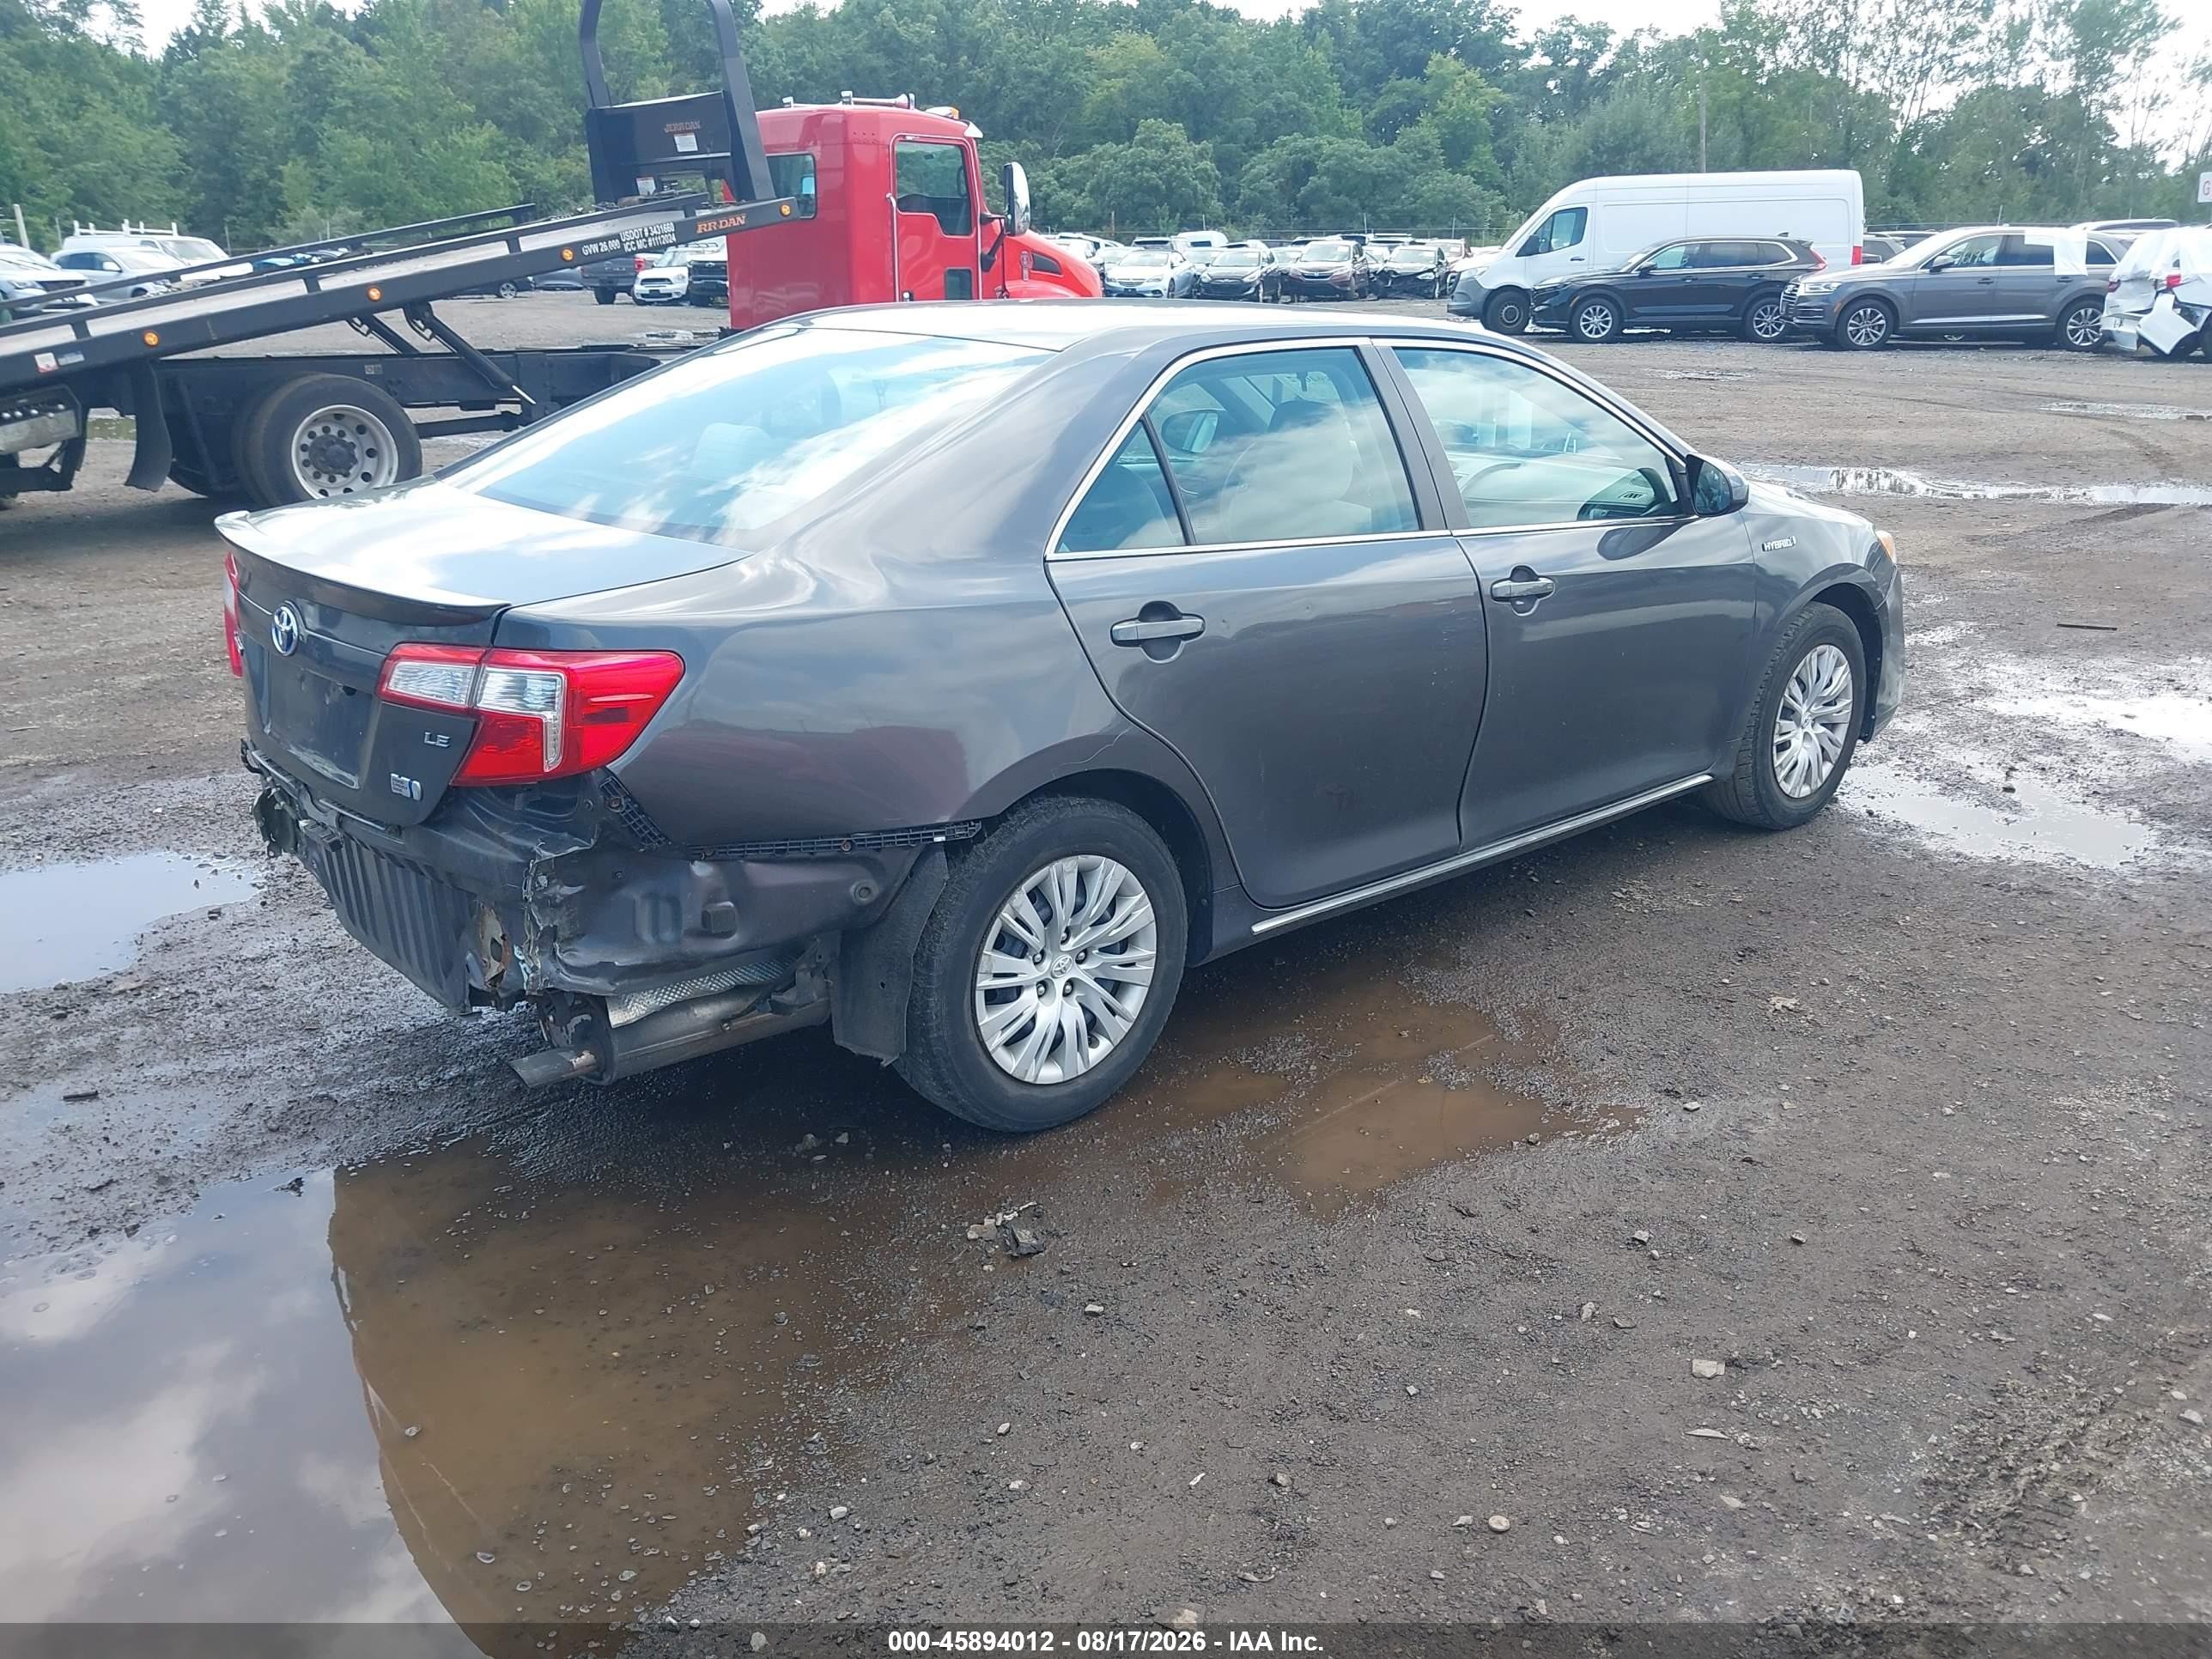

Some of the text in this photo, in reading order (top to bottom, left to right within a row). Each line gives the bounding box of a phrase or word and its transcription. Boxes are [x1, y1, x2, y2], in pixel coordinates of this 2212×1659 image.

[620, 228, 643, 242] USDOT
[581, 243, 599, 256] GVW
[623, 241, 636, 252] ICC
[636, 238, 647, 250] MC
[424, 732, 451, 748] LE
